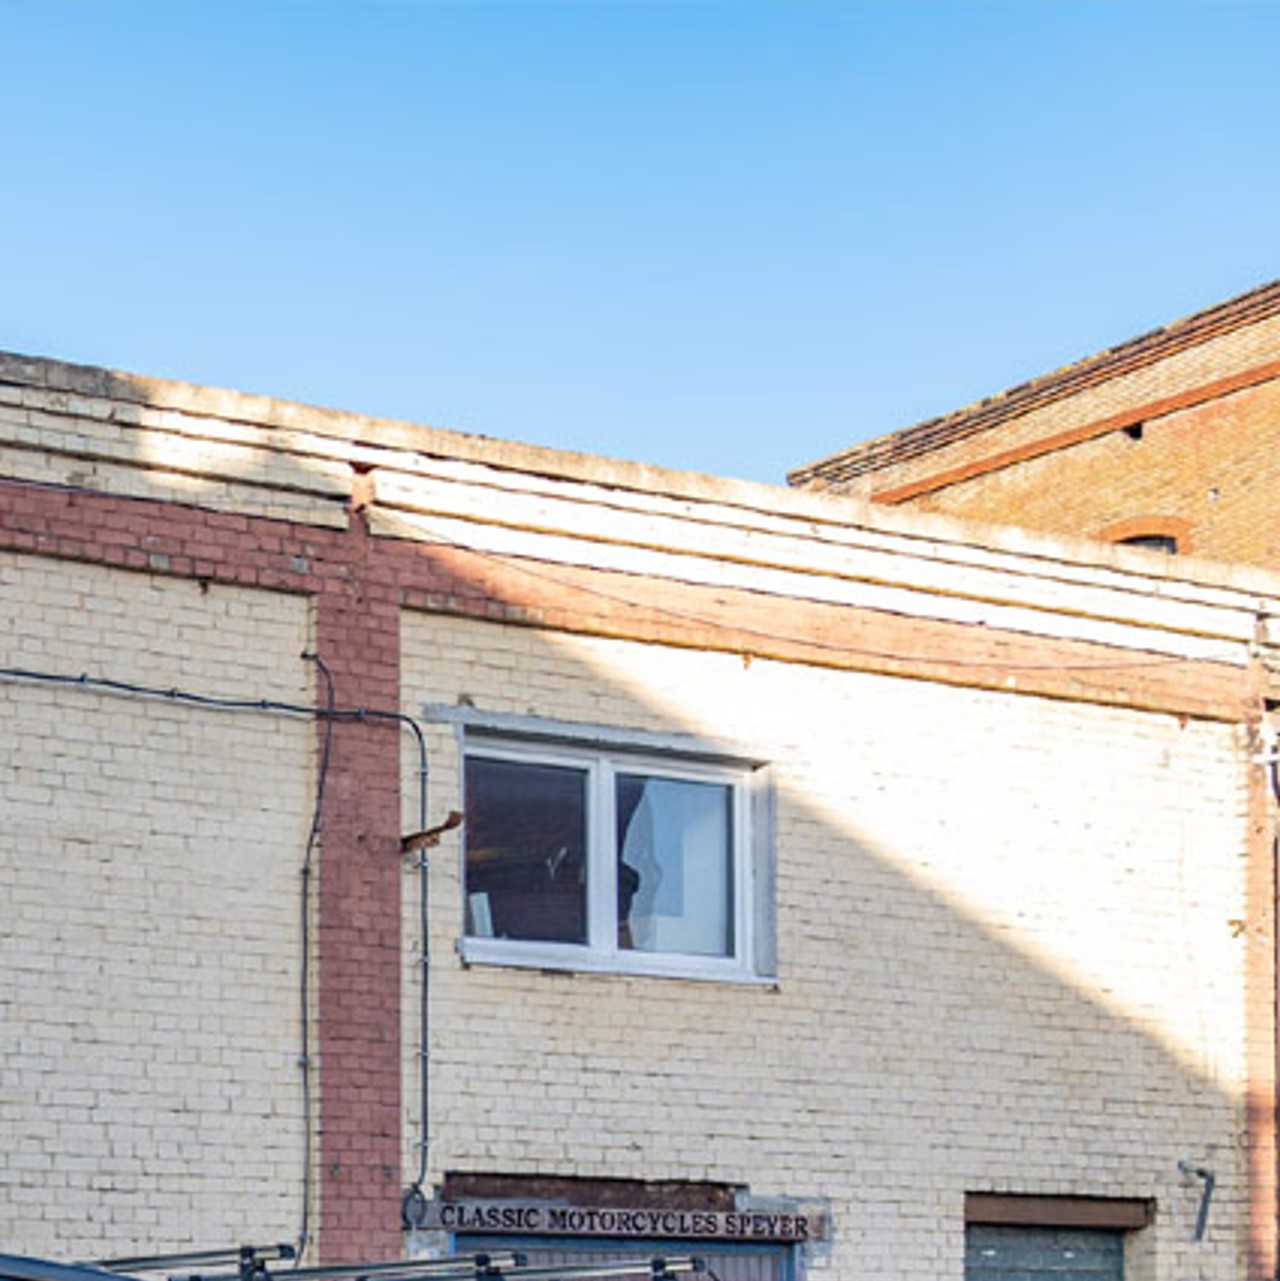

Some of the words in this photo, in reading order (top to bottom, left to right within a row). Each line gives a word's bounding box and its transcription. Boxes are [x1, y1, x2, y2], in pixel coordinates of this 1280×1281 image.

[440, 1205, 539, 1230] CLASSIC
[548, 1208, 718, 1234] MOTORCYCLES
[725, 1211, 808, 1237] SPEYER
